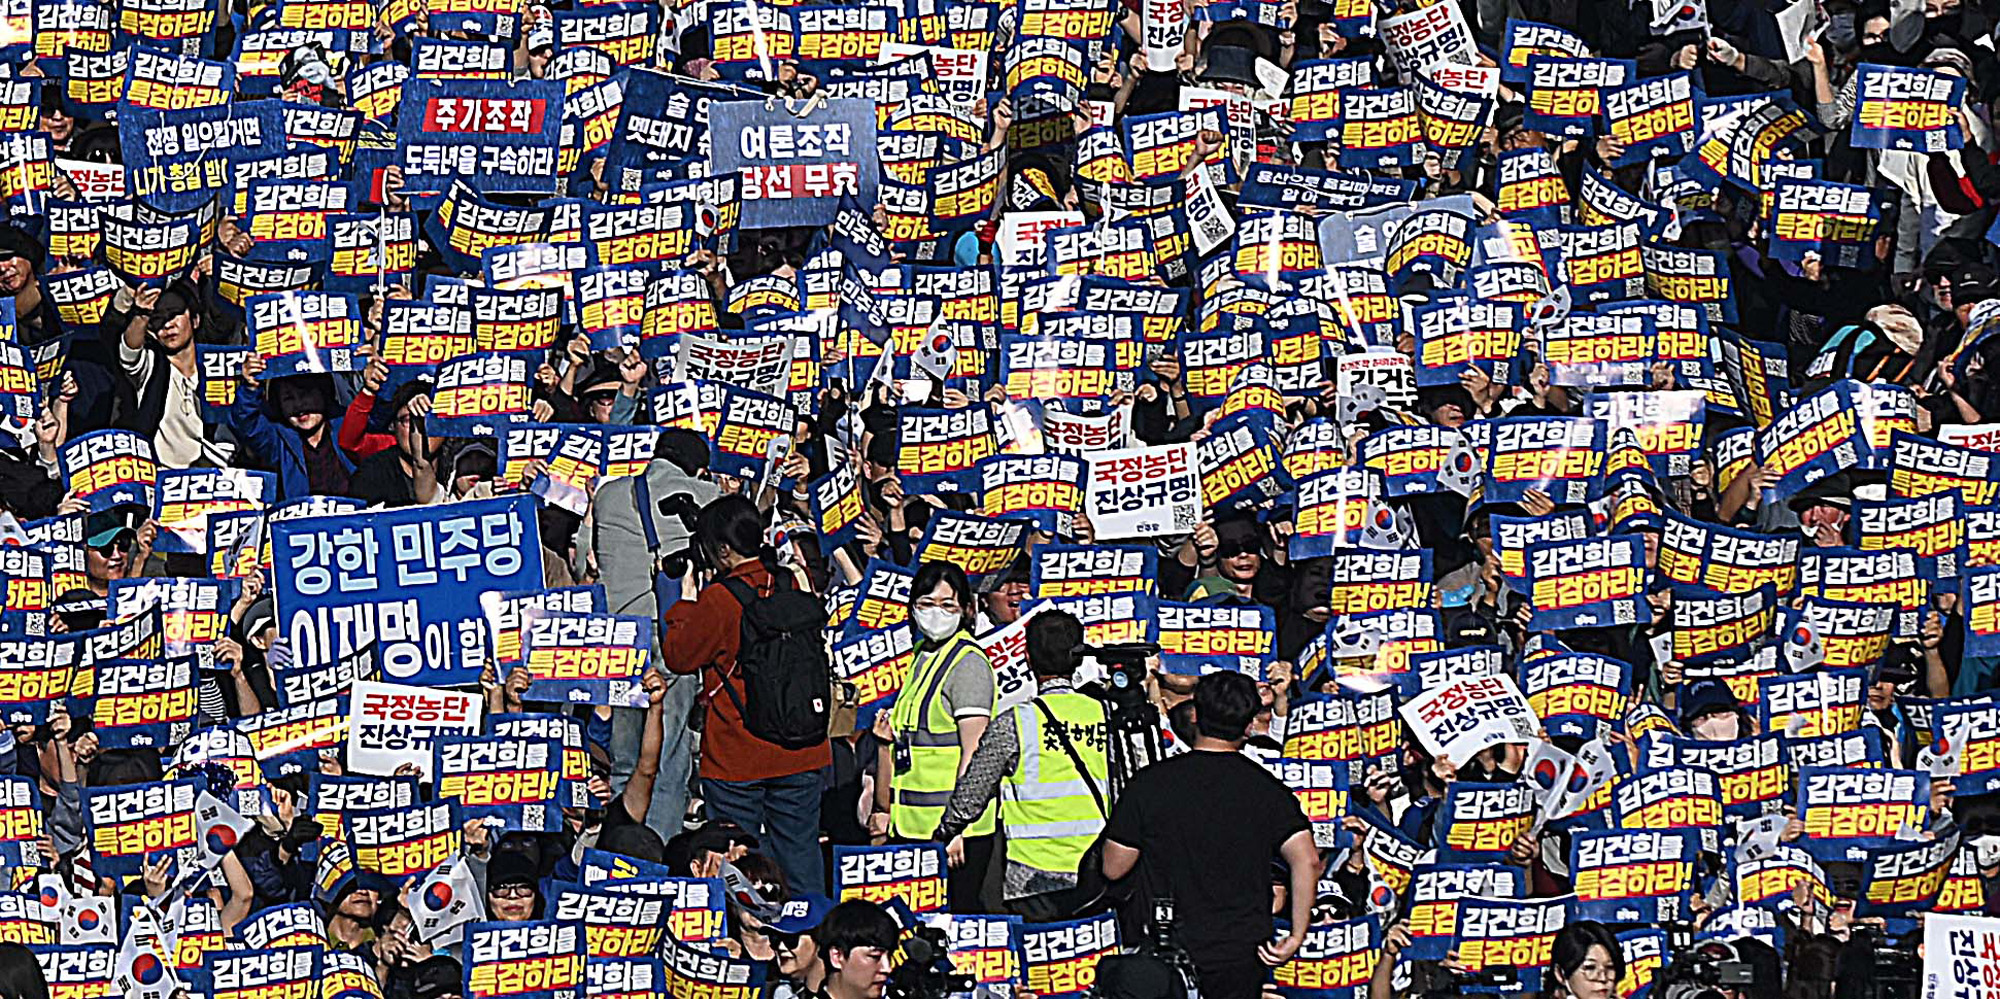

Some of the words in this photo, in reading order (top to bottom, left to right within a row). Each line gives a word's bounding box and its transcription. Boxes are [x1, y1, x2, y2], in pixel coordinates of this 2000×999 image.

[121, 10, 214, 38] 특검하라!
[281, 3, 376, 28] 특검하라!
[561, 18, 648, 42] 김건희를
[800, 7, 885, 32] 김건희를
[1021, 12, 1114, 37] 특검하라!
[132, 52, 223, 86] 김건희를
[418, 45, 505, 70] 김건희를
[1293, 61, 1372, 93] 김건희를
[1533, 60, 1625, 90] 김건희를
[1864, 72, 1953, 100] 김건희를
[666, 92, 690, 119] 술
[1606, 75, 1691, 118] 김건희를
[435, 98, 532, 132] 주가조작
[1131, 112, 1219, 144] 김건희를
[626, 115, 694, 152] 멧돼지
[740, 123, 852, 160] 여론조작
[404, 145, 477, 175] 도둑년을
[481, 145, 554, 175] 구속하라
[133, 167, 166, 196] 니가
[739, 165, 792, 199] 당선
[804, 163, 858, 197] 무효
[254, 185, 346, 210] 김건희를
[1779, 186, 1870, 212] 김건희를
[455, 201, 543, 231] 김건희를
[589, 206, 682, 239] 김건희를
[1776, 213, 1873, 242] 특검하라!
[105, 219, 188, 250] 김건희를
[598, 230, 692, 261] 특검하라!
[834, 210, 885, 257] 민주당
[1054, 228, 1144, 260] 김건희를
[1354, 224, 1378, 254] 술
[105, 247, 197, 278] 특검하라!
[219, 261, 310, 288] 김건희를
[491, 246, 586, 278] 김건희를
[254, 296, 346, 328] 김건희를
[475, 293, 558, 320] 김건희를
[1086, 287, 1180, 314] 김건희를
[386, 306, 471, 334] 김건희를
[1420, 305, 1513, 337] 김건희를
[255, 322, 360, 358] 특검하라!
[690, 342, 786, 368] 국정농단
[1008, 341, 1105, 368] 김건희를
[1184, 334, 1263, 366] 김건희를
[1420, 334, 1521, 367] 특검하라!
[1544, 334, 1655, 363] 특검하라!
[438, 354, 526, 388] 김건희를
[1005, 370, 1114, 399] 특검하라!
[432, 386, 532, 414] 특검하라!
[726, 394, 795, 432] 김건희를
[902, 410, 989, 442] 김건희를
[1045, 412, 1121, 446] 국정농단
[1496, 422, 1596, 451] 김건희를
[1761, 391, 1840, 457] 김건희를
[65, 433, 151, 471] 김건희를
[898, 437, 998, 474] 특검하라!
[1765, 408, 1856, 474] 특검하라!
[983, 461, 1079, 488] 김건희를
[1095, 447, 1189, 484] 국정농단
[1492, 452, 1602, 482] 특검하라!
[1895, 440, 1990, 477] 김건희를
[983, 486, 1083, 516] 특검하라!
[1095, 476, 1197, 515] 진상규명!
[1135, 521, 1160, 533] 민주당
[1860, 497, 1954, 529] 김건희를
[936, 516, 1021, 546] 김건희를
[1500, 514, 1588, 548] 김건희를
[289, 527, 379, 595] 강한
[393, 510, 523, 588] 민주당
[1040, 549, 1144, 580] 김건희를
[1532, 541, 1632, 579] 김건희를
[1711, 534, 1798, 567] 김건희를
[1334, 553, 1421, 583] 김건희를
[1824, 552, 1915, 584] 김건희를
[1332, 583, 1430, 615] 특검하라!
[1531, 568, 1644, 610] 특검하라!
[1157, 606, 1262, 629] 김건희를
[1673, 591, 1766, 627] 김건희를
[1812, 604, 1894, 635] 김건희를
[532, 617, 637, 646] 김건희를
[1157, 631, 1273, 655] 특검하라!
[1673, 603, 1777, 658] 특검하라!
[99, 663, 191, 693] 김건희를
[528, 648, 646, 678] 특검하라!
[1525, 655, 1622, 695] 김건희를
[94, 690, 199, 724] 특검하라!
[362, 694, 470, 722] 국정농단
[1417, 677, 1508, 724] 국정농단
[1767, 678, 1861, 713] 김건희를
[1429, 695, 1527, 747] 진상규명!
[439, 740, 549, 774] 김건희를
[1681, 737, 1779, 773] 김건희를
[90, 786, 195, 815] 김건희를
[318, 780, 412, 811] 김건희를
[439, 771, 558, 805] 특검하라!
[1617, 768, 1714, 814] 김건희를
[1807, 774, 1915, 804] 김건희를
[352, 804, 450, 845] 김건희를
[1804, 804, 1925, 837] 특검하라!
[355, 830, 462, 875] 특검하라!
[1578, 834, 1683, 867] 김건희를
[839, 850, 939, 885] 김건희를
[1575, 862, 1692, 899] 특검하라!
[557, 892, 664, 923] 김건희를
[1461, 904, 1566, 937] 김건희를
[244, 905, 326, 950] 김건희를
[472, 925, 576, 960] 김건희를
[1023, 919, 1116, 962] 김건희를
[213, 951, 312, 988] 김건희를
[469, 955, 586, 996] 특검하라!
[1273, 948, 1380, 988] 특검하라!
